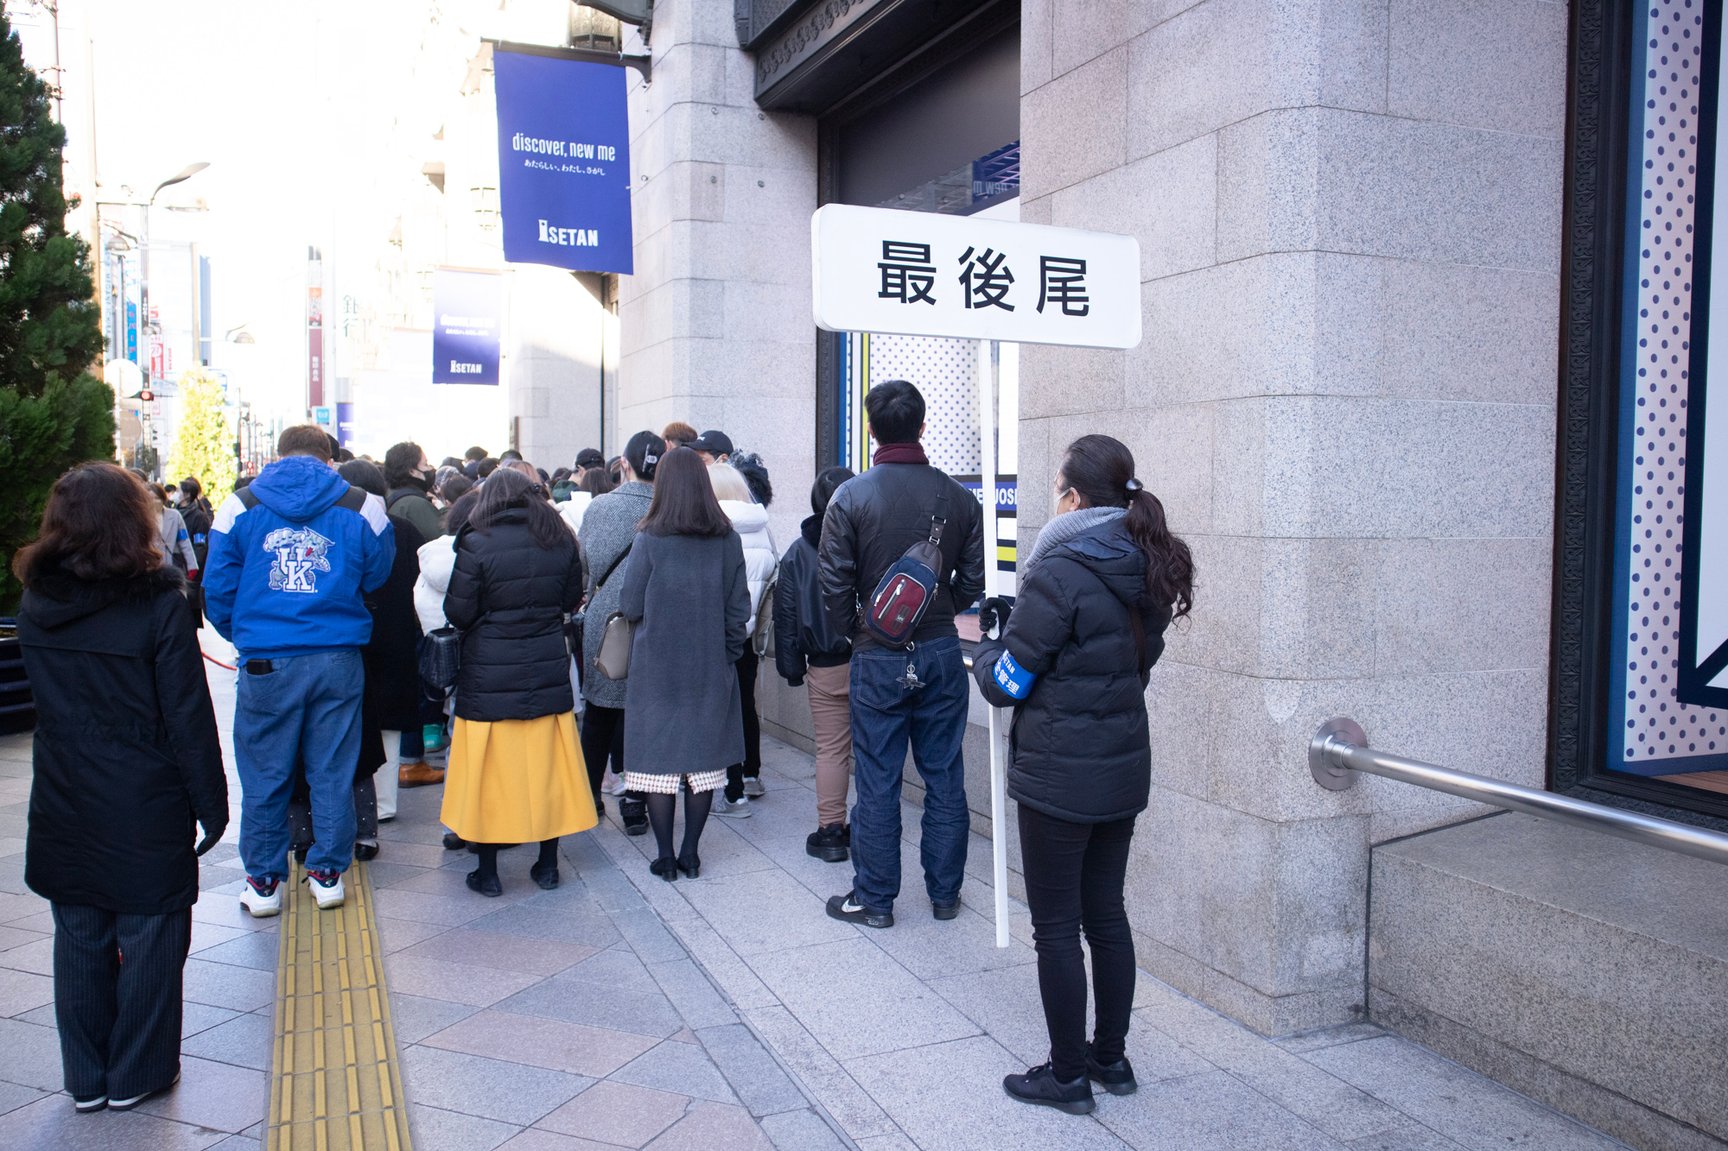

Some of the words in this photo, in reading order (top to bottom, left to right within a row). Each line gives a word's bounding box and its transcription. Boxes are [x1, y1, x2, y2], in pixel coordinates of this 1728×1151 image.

[512, 132, 568, 157] discover,
[570, 142, 595, 159] new
[597, 144, 616, 161] me
[538, 219, 599, 247] ISETAN
[877, 239, 1090, 317] 最後尾
[450, 360, 482, 374] ISETAN
